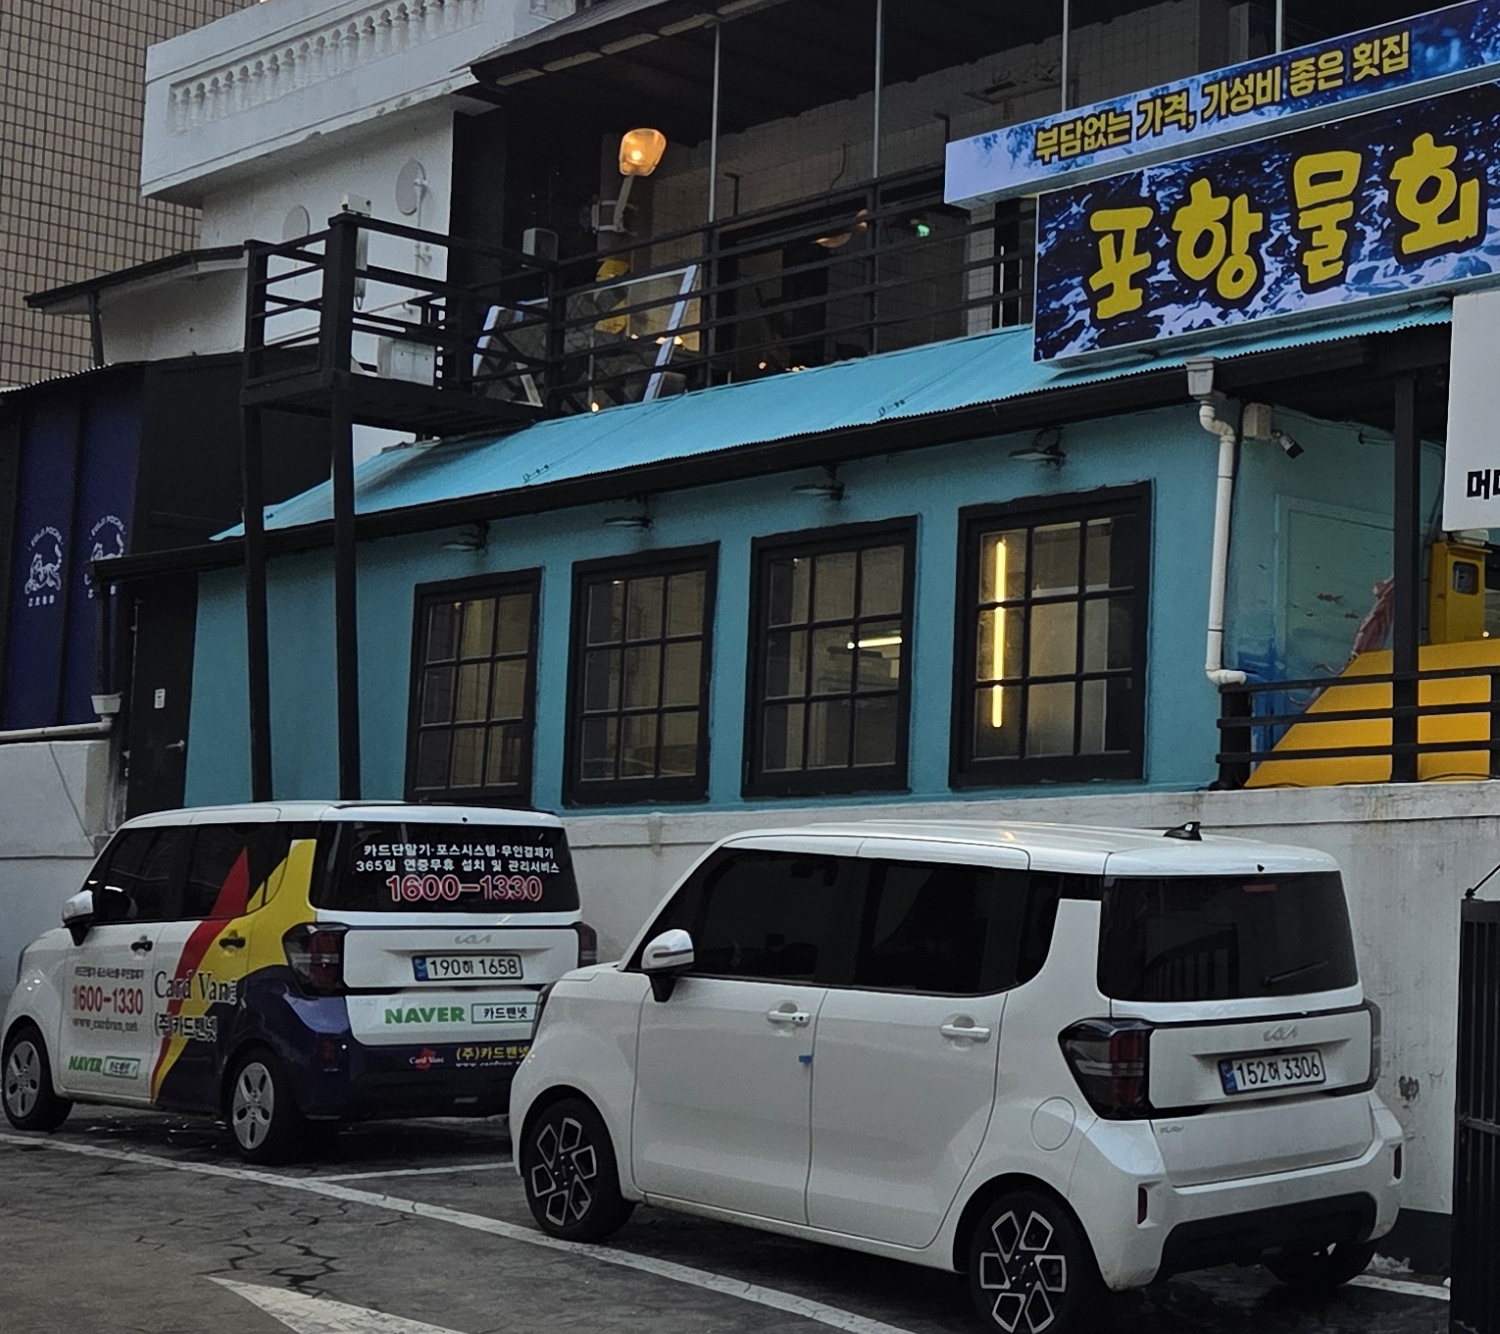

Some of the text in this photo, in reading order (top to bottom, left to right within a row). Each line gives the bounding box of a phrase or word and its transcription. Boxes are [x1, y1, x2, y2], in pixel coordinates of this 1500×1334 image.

[1036, 112, 1131, 163] 부담없는
[1203, 69, 1282, 122] 가성비
[1290, 50, 1345, 98] 좋은
[1352, 32, 1410, 80] 횟집
[1089, 133, 1481, 320] 포항물회
[356, 859, 396, 872] 365일
[403, 859, 454, 872] 연중무휴
[461, 859, 485, 872] 설치
[508, 860, 560, 873] 관리서비스
[386, 874, 543, 902] 1600-1330
[479, 958, 518, 976] 1658
[154, 969, 194, 1000] Card
[72, 985, 143, 1015] 1600-1330
[385, 1007, 465, 1024] NAVER
[69, 1055, 103, 1073] NAVER
[1282, 1055, 1320, 1080] 3306
